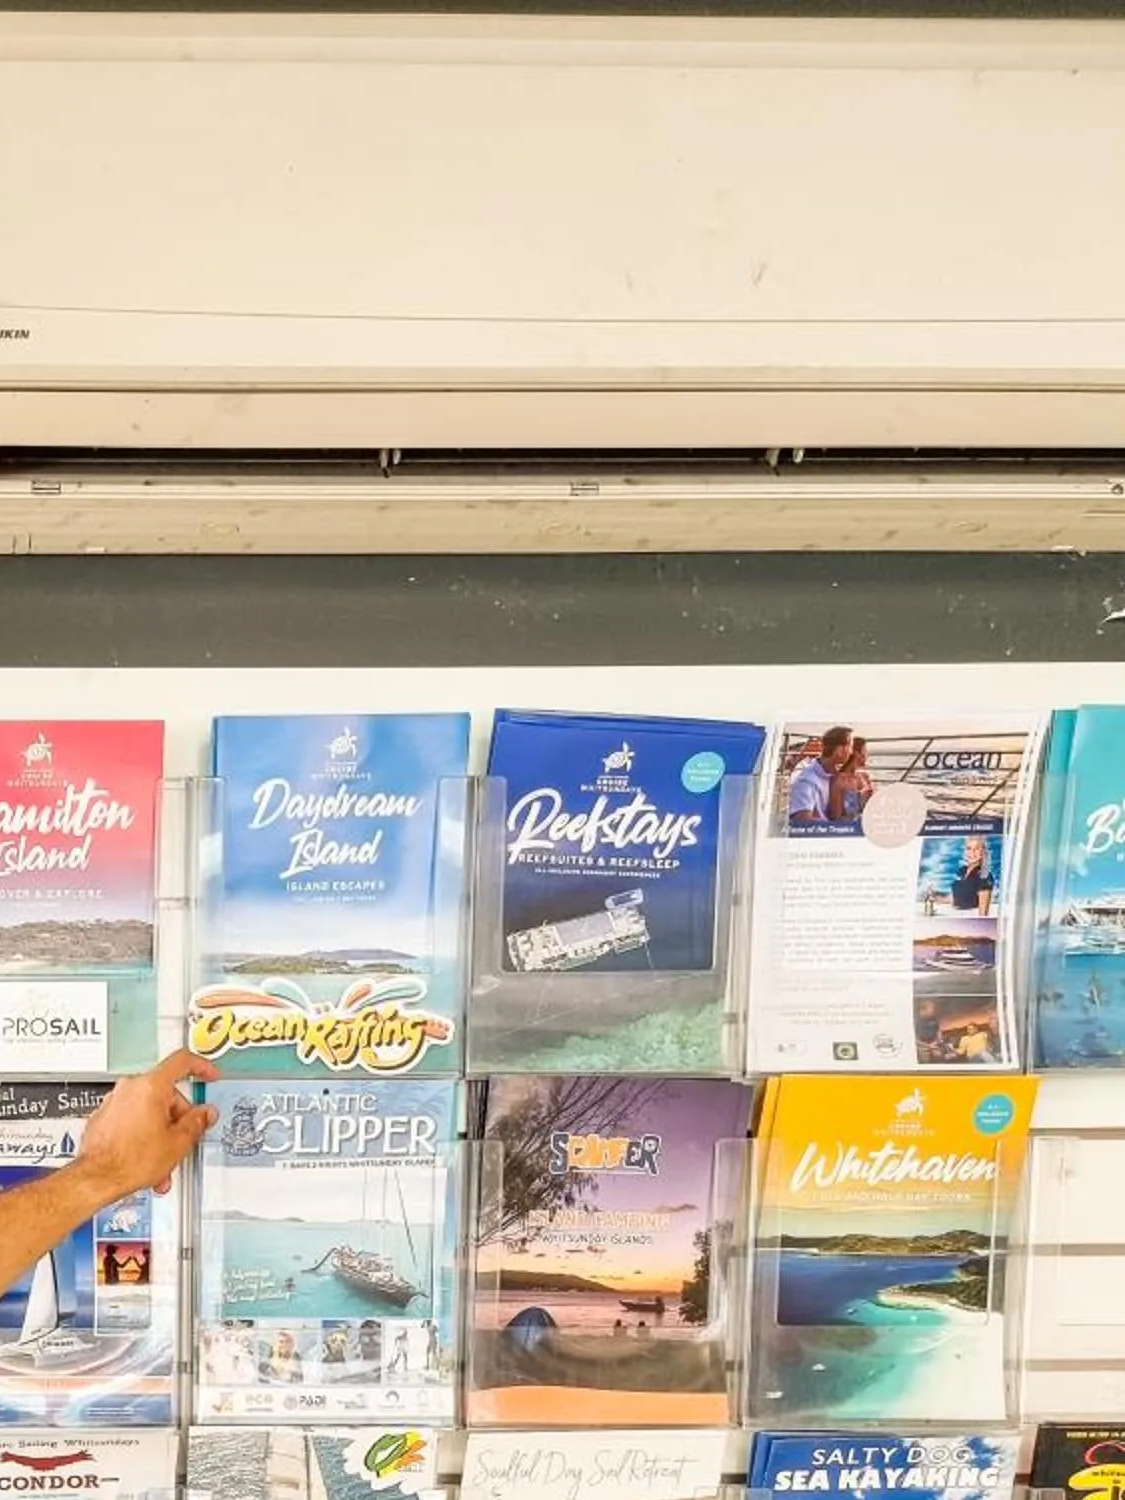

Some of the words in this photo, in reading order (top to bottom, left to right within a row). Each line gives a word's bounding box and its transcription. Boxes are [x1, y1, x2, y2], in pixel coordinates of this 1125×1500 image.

[925, 751, 1003, 771] ocean
[248, 777, 423, 830] Daydream
[507, 787, 702, 865] Reefstays
[279, 828, 384, 880] Island
[286, 880, 329, 893] ISLAND
[2, 1017, 102, 1037] PROSAIL
[190, 1007, 305, 1055] Ocean
[302, 1001, 431, 1069] Rafting
[259, 1092, 379, 1113] ATLANTIC
[255, 1114, 438, 1155] CLIPPER
[789, 1139, 1000, 1194] Whitehaven
[18, 1440, 59, 1450] Sailing
[812, 1446, 901, 1466] SALTY
[906, 1446, 972, 1465] DOG
[774, 1469, 831, 1492] SEA
[838, 1466, 1000, 1491] KAYAKING
